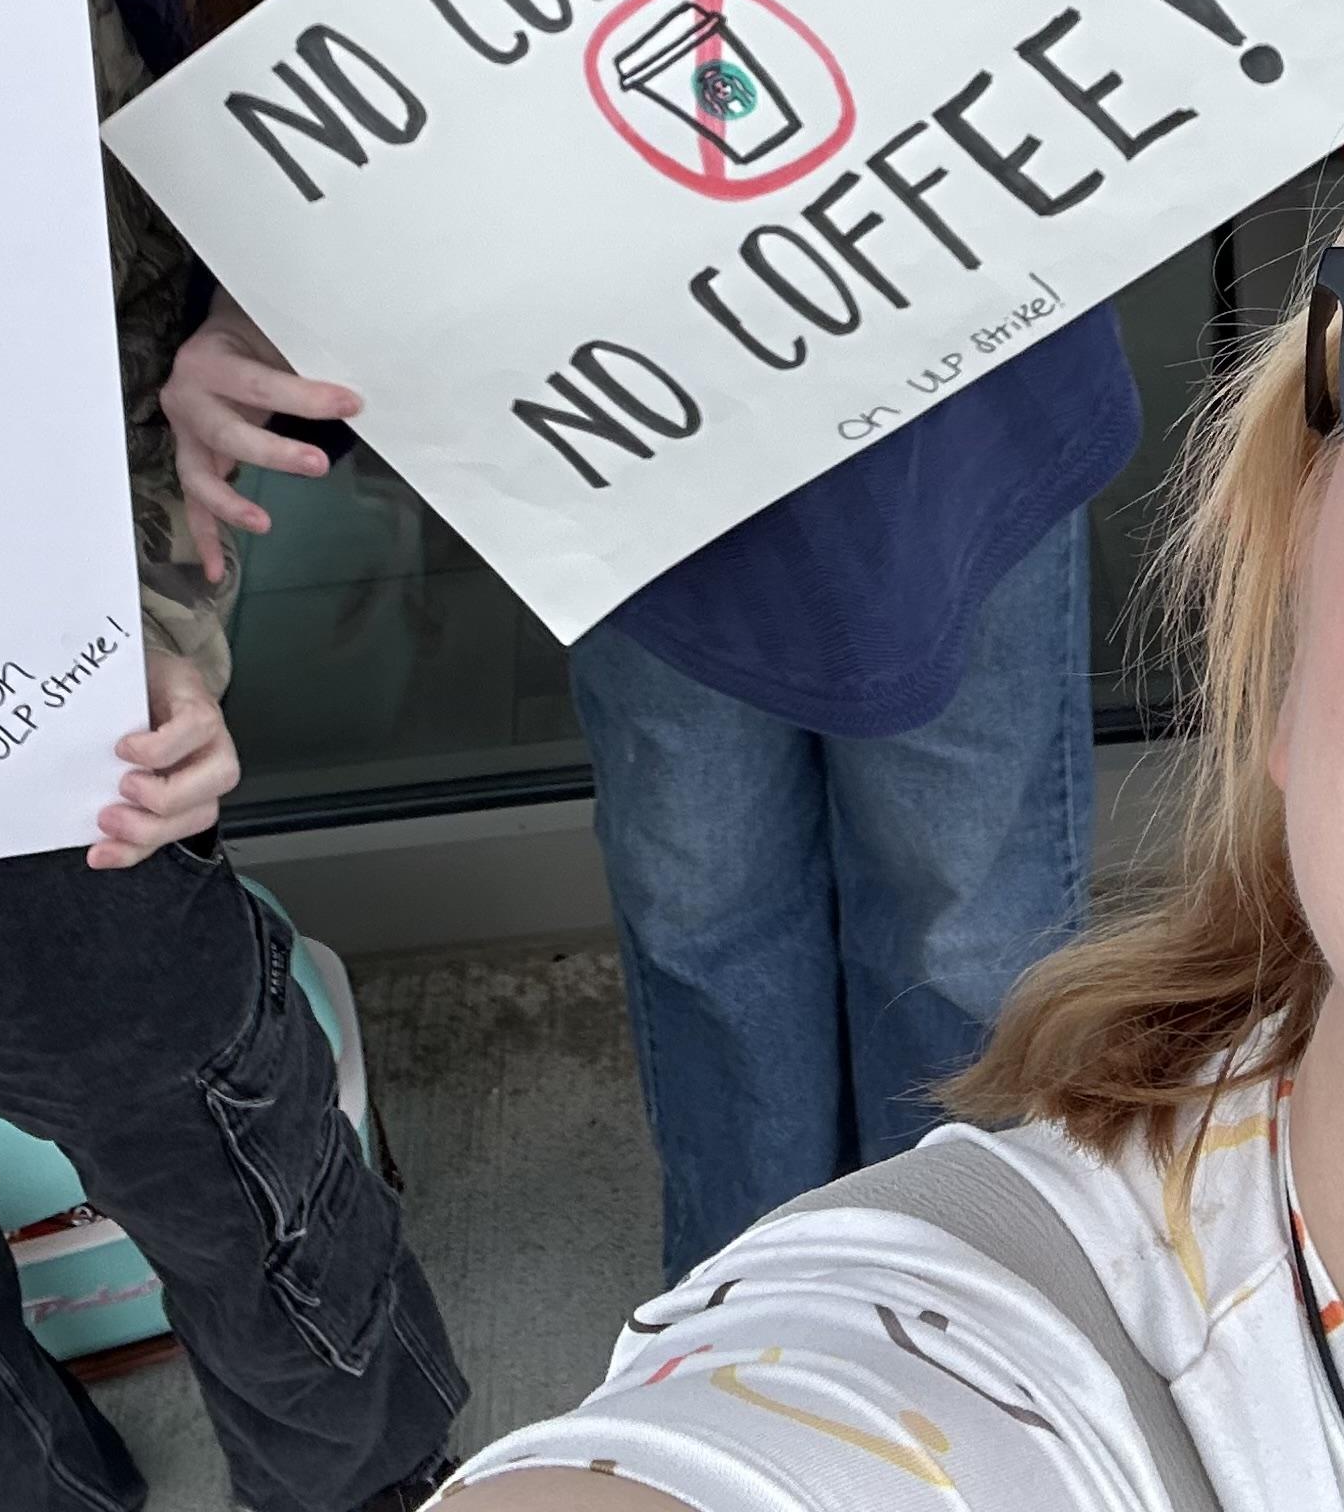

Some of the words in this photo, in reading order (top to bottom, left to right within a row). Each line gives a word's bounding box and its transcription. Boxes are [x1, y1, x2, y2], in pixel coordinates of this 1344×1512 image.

[224, 24, 427, 203] NO
[511, 340, 702, 489] NO
[906, 352, 963, 394] ULP
